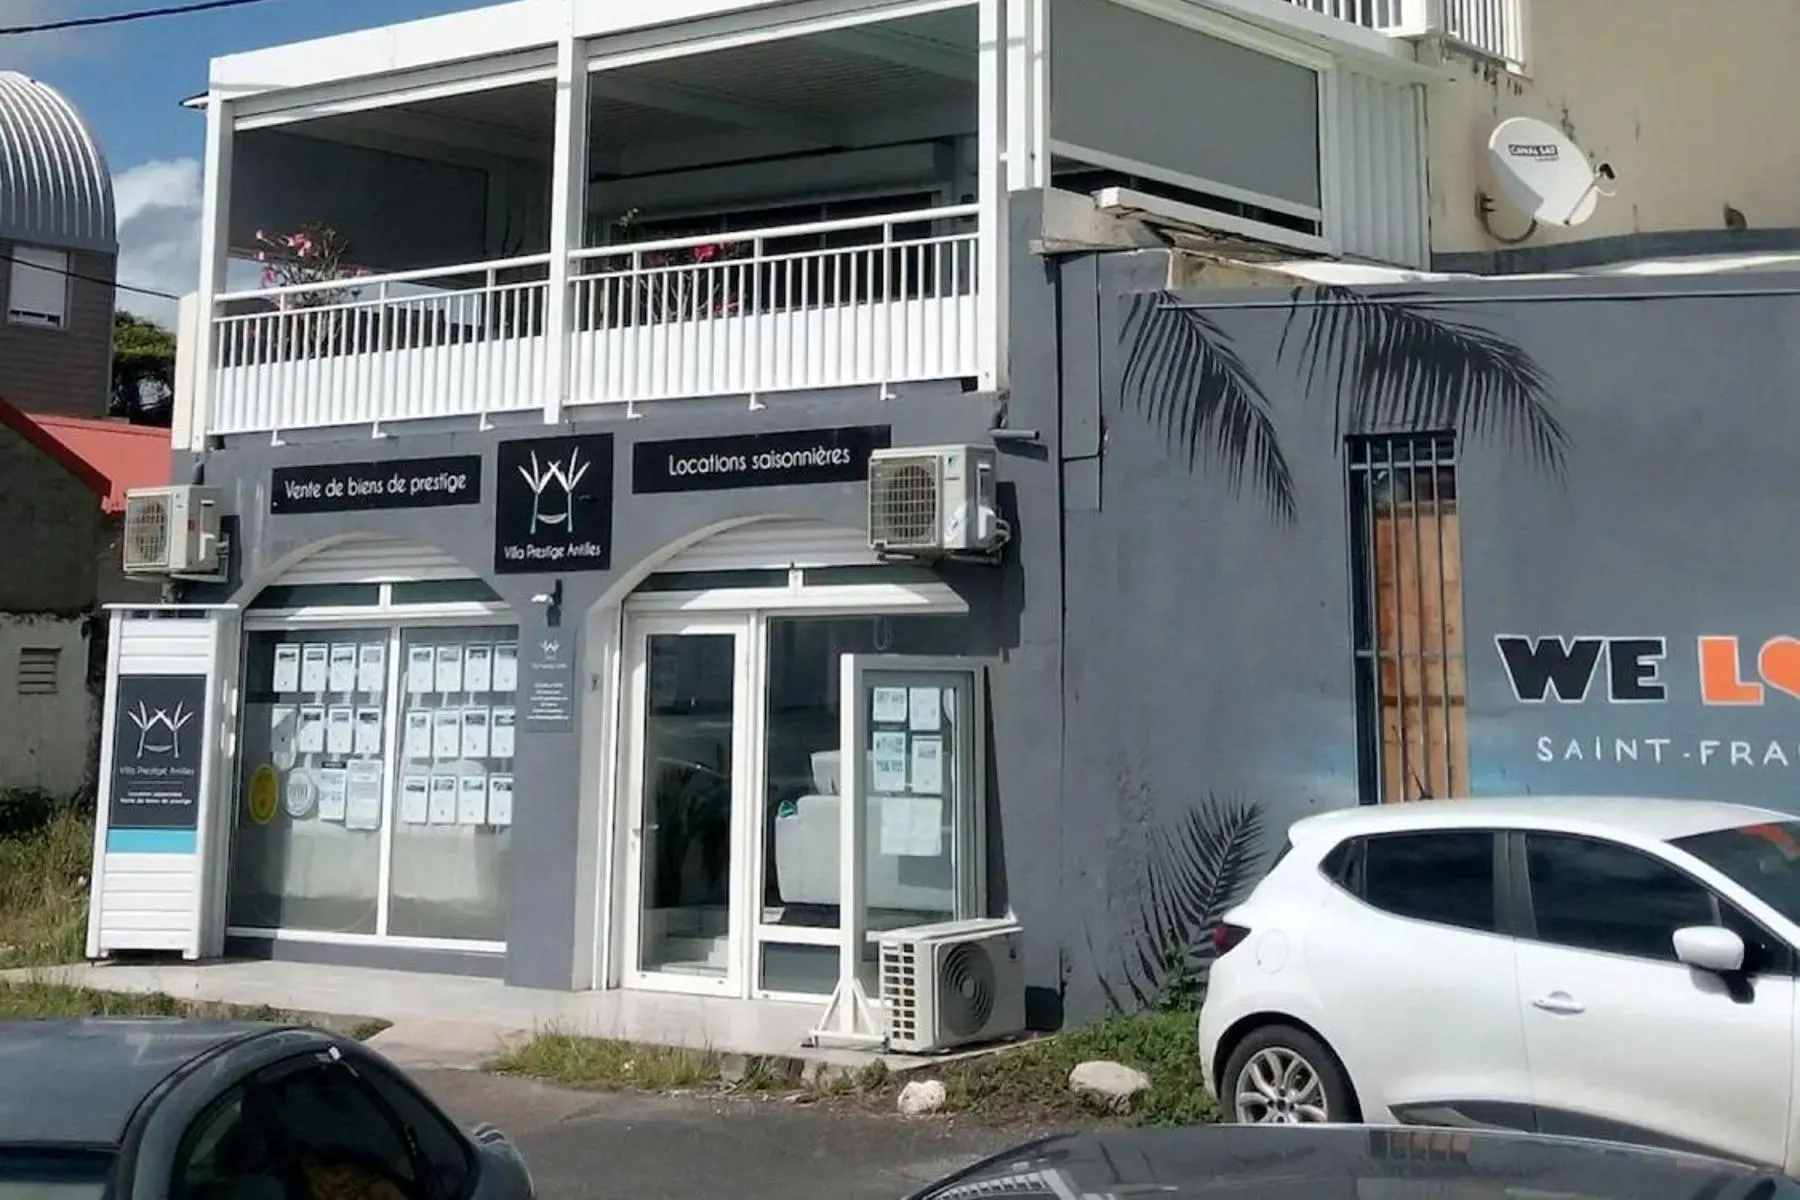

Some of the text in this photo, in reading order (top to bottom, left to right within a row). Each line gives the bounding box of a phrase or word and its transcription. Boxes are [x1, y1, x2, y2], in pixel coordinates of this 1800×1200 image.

[668, 445, 850, 476] Locations saisonnières
[284, 472, 467, 500] Vente de biens de prestige
[503, 541, 601, 560] Villa Prestige Antilles
[1494, 633, 1668, 704] WE
[1536, 735, 1800, 767] SAINT-FRA
